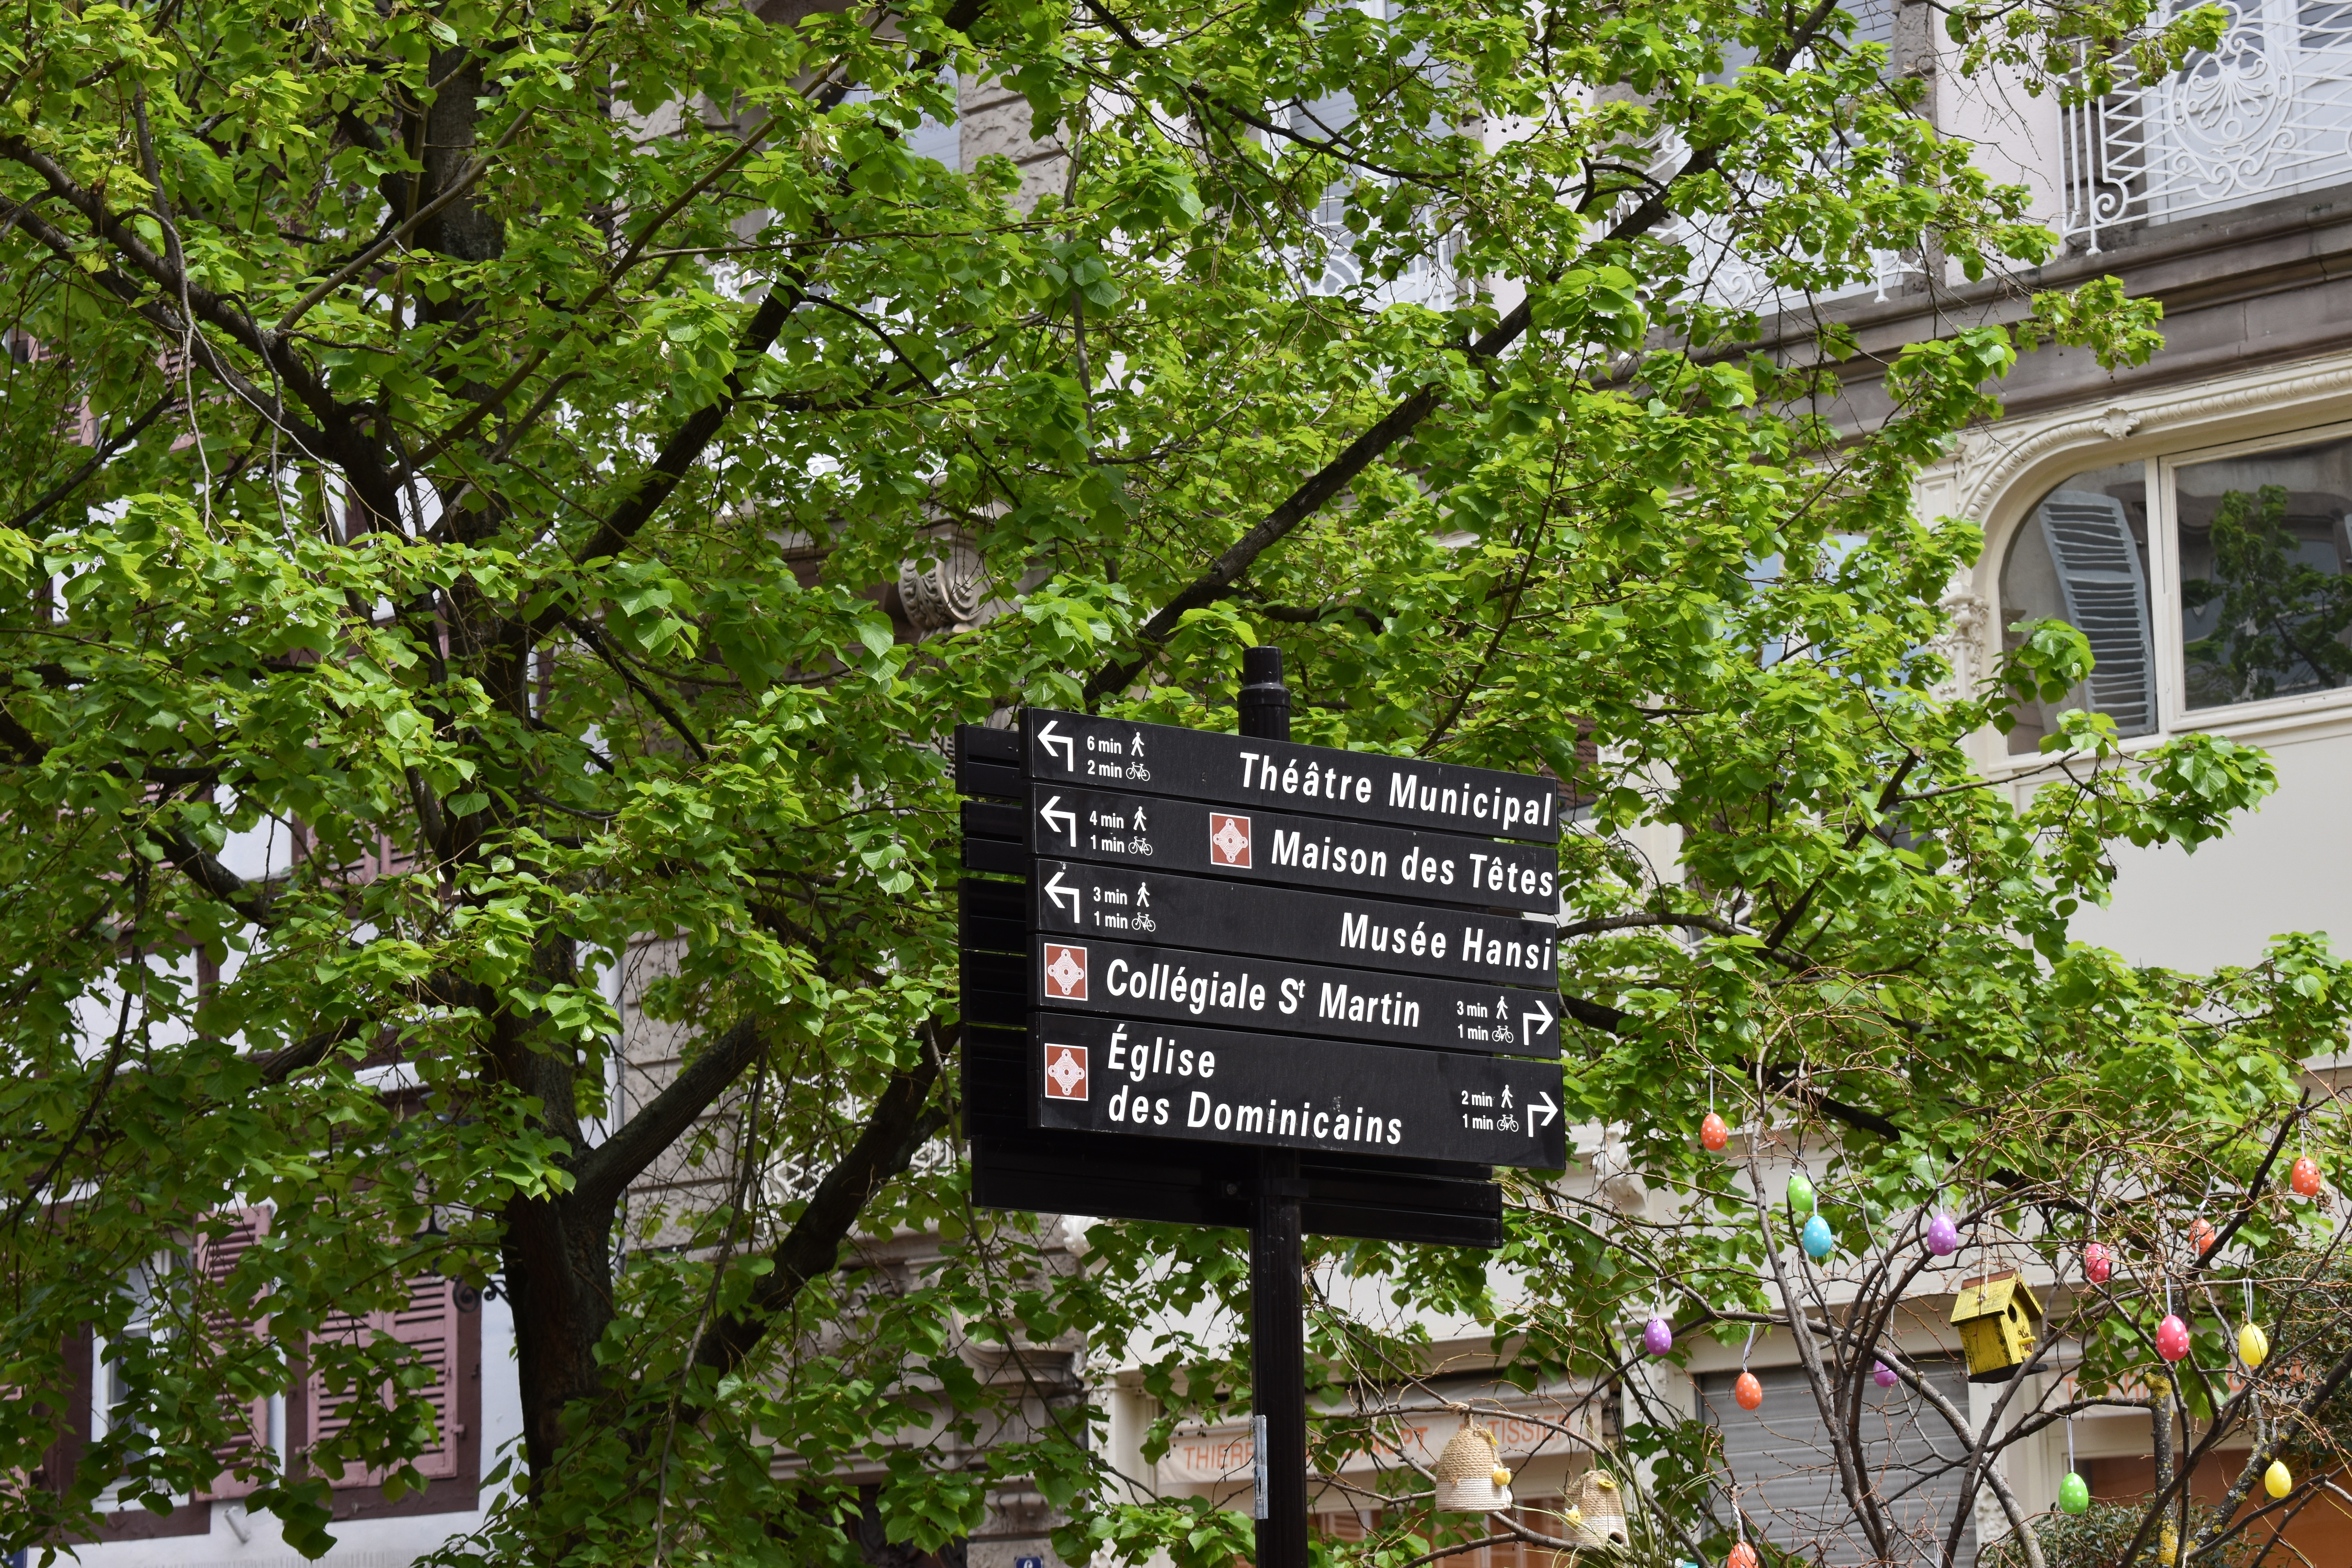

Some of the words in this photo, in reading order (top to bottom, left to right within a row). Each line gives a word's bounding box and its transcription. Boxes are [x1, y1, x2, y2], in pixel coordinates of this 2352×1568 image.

[1087, 735, 1095, 751] 6
[1098, 738, 1122, 755] min
[1087, 759, 1095, 775] 2
[1099, 762, 1122, 779] min
[1240, 752, 1372, 803] Théâtre
[1389, 772, 1552, 830] Municipal
[1089, 810, 1098, 826] 4
[1101, 813, 1124, 829] min
[1090, 835, 1096, 849] 1
[1101, 837, 1125, 853] min
[1271, 829, 1387, 877] Maison
[1401, 846, 1455, 885] des
[1469, 853, 1553, 897] Têtes
[1093, 886, 1101, 902] 3
[1104, 889, 1127, 905] min
[1094, 911, 1100, 926] 1
[1105, 913, 1128, 929] min
[1340, 912, 1446, 958] Musée
[1462, 927, 1551, 971] Hansi
[1107, 959, 1265, 1014] Collégiale
[1278, 978, 1305, 1014] St
[1319, 982, 1419, 1027] Martin
[1457, 1000, 1464, 1015] 3
[1467, 1002, 1488, 1018] min
[1457, 1024, 1463, 1038] 1
[1467, 1025, 1488, 1041] min
[1108, 1023, 1215, 1082] Église
[1461, 1090, 1469, 1105] 2
[1471, 1091, 1493, 1107] min
[1109, 1085, 1169, 1125] des
[1187, 1091, 1402, 1145] Dominicains
[1462, 1113, 1468, 1128] 1
[1472, 1115, 1494, 1131] min
[1183, 1442, 1254, 1470] THIER
[1458, 1414, 1571, 1444] TISSIER
